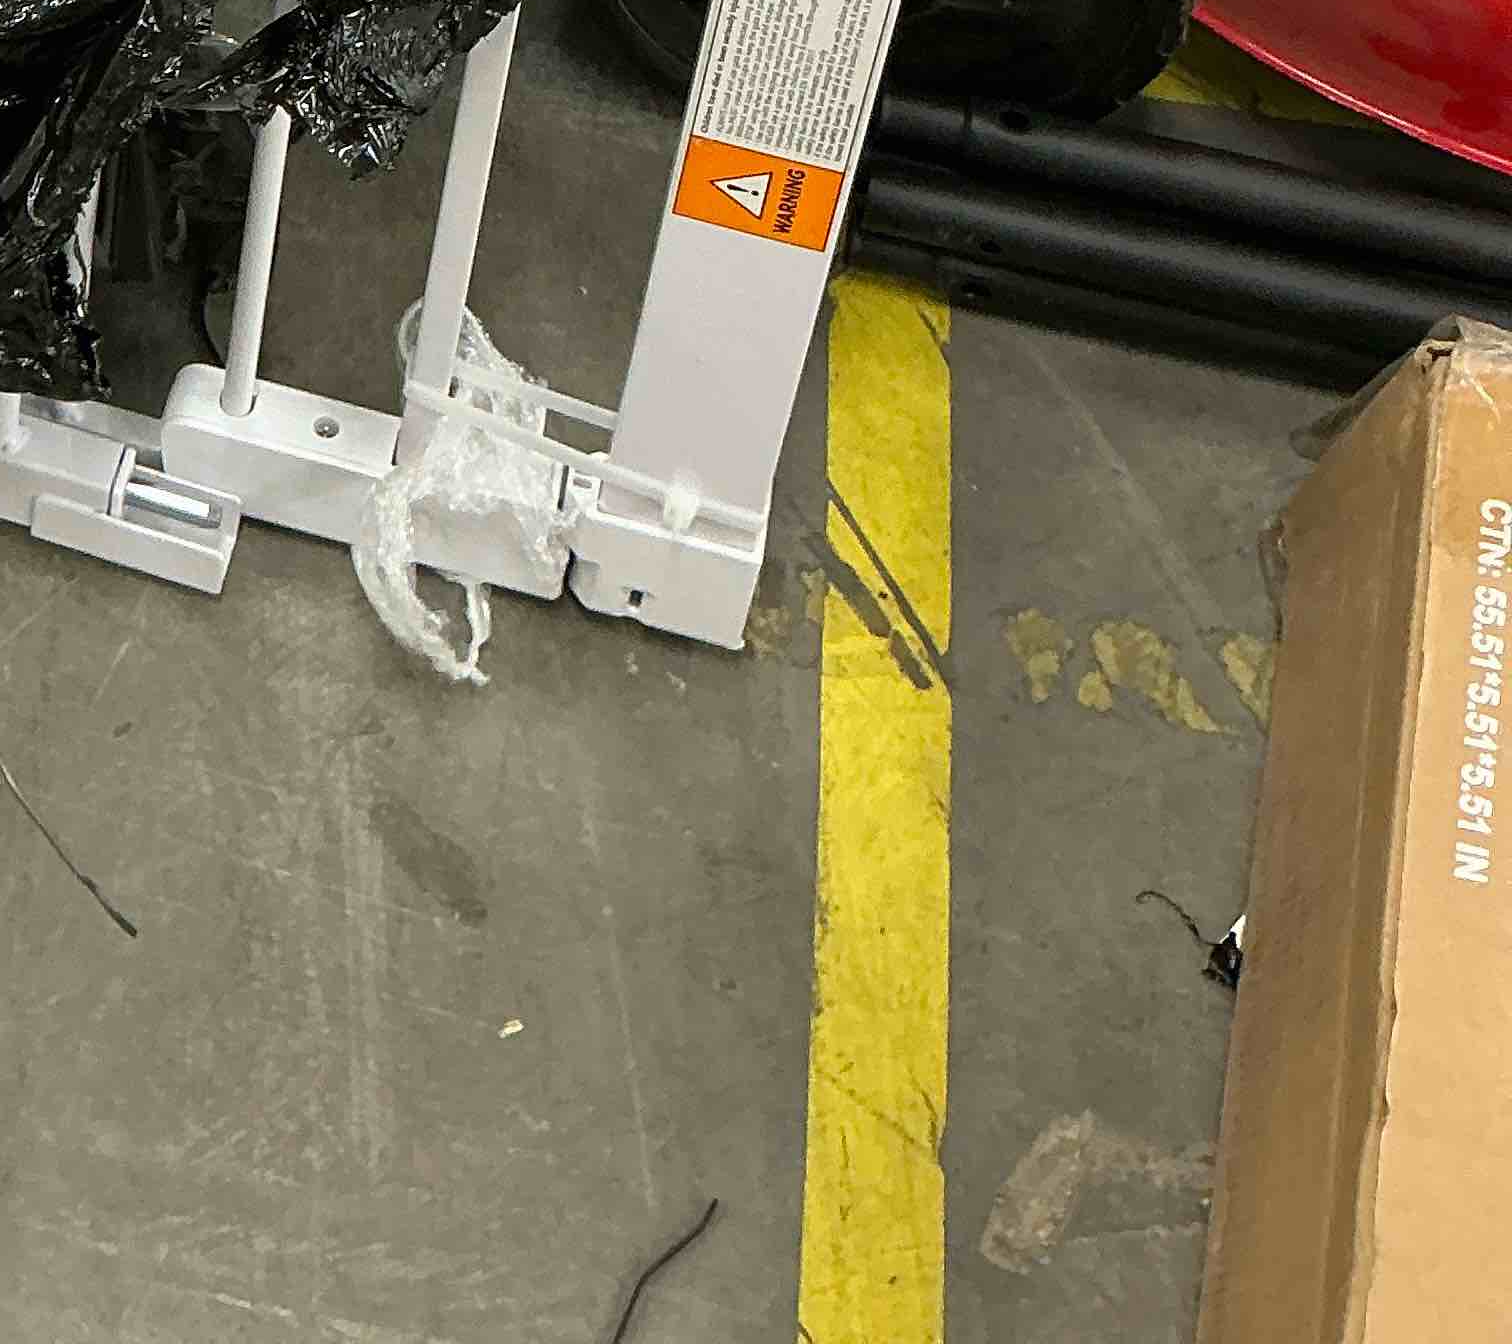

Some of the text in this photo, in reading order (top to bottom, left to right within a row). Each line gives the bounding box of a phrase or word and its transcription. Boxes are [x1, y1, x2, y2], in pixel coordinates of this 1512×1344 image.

[773, 168, 807, 233] WARNING
[1477, 498, 1512, 577] CTN:
[1451, 844, 1490, 884] IN
